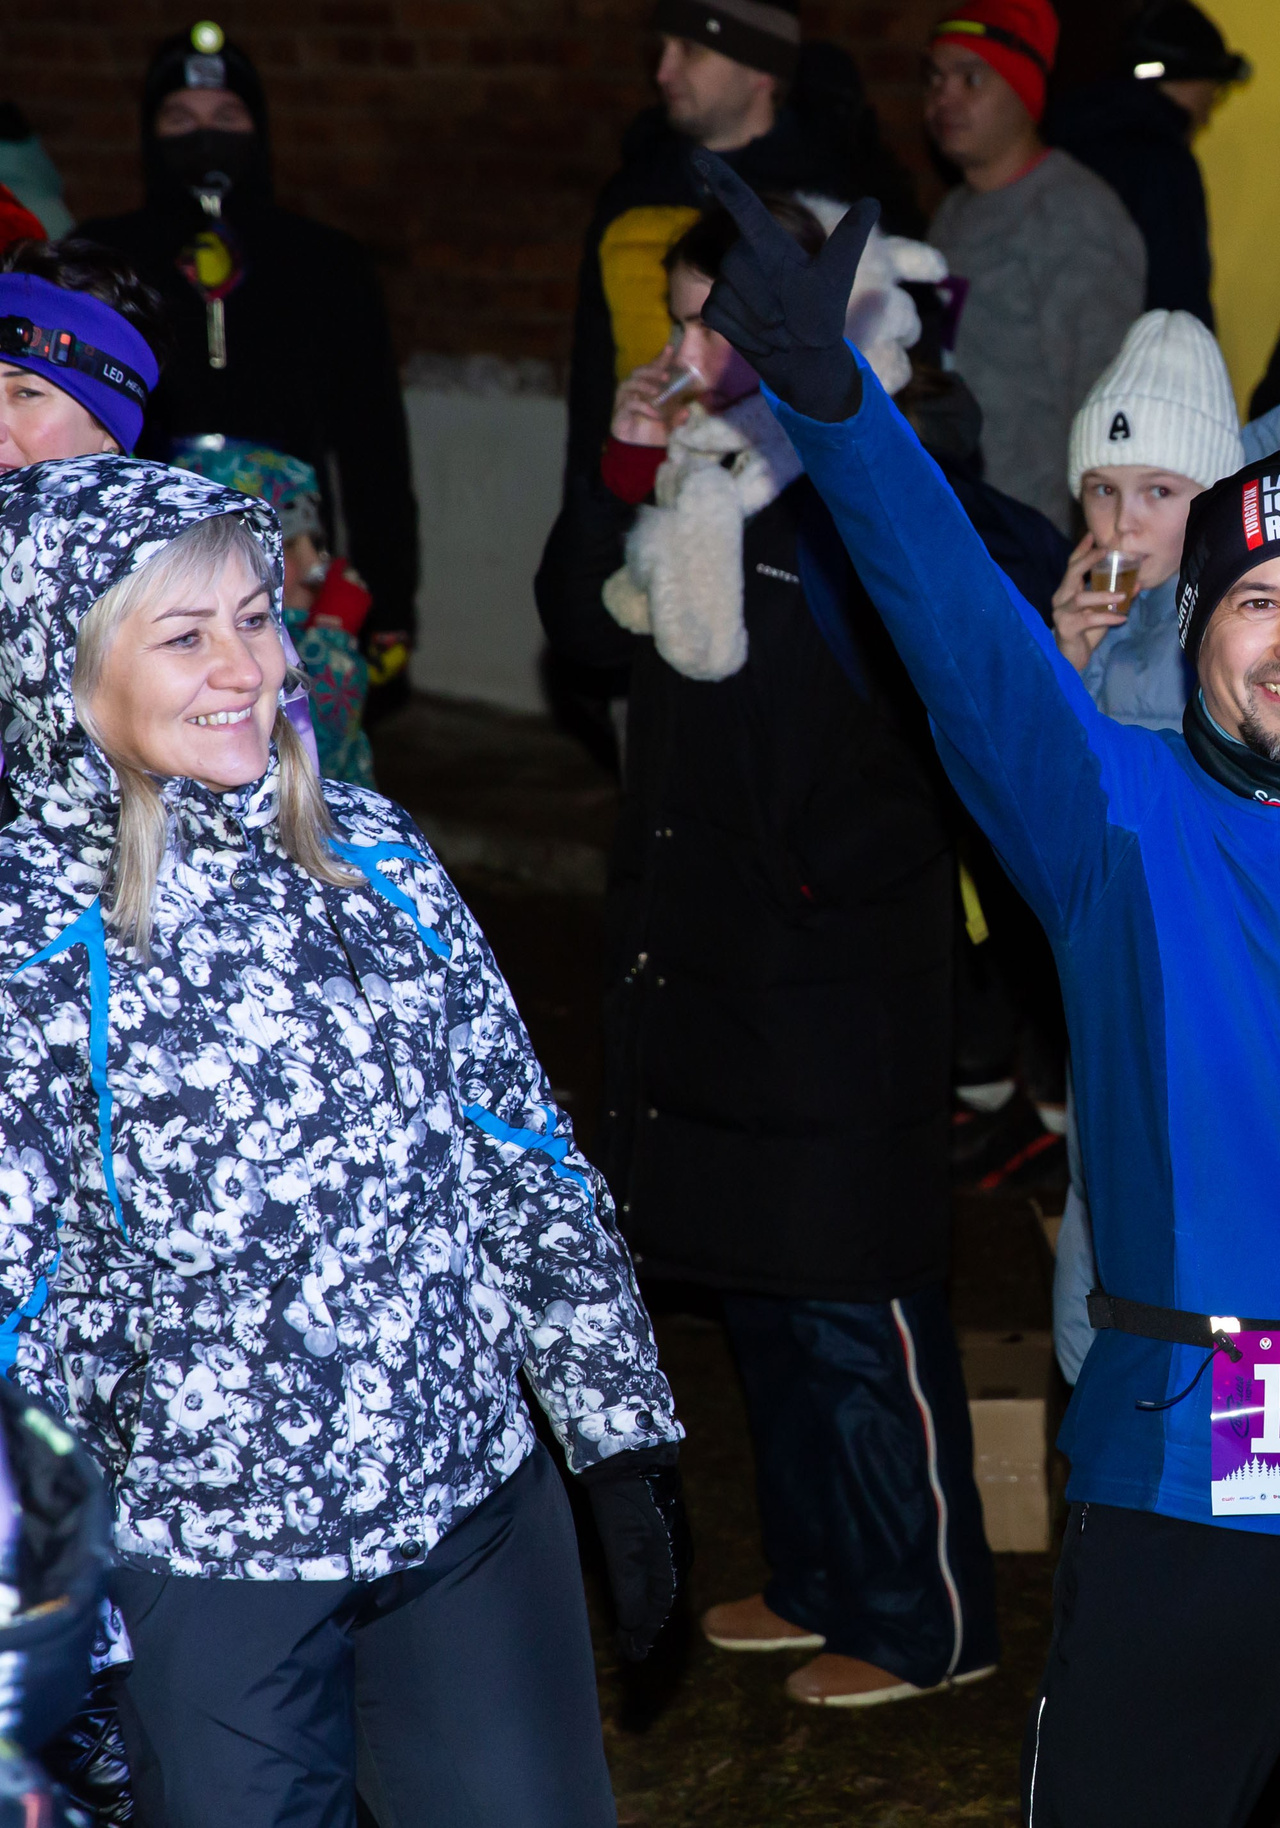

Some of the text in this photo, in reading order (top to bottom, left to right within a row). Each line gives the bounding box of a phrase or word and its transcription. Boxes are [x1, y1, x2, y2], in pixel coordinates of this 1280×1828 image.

[103, 363, 124, 384] LED
[1109, 411, 1131, 440] A
[1243, 485, 1260, 539] TURGOYAK
